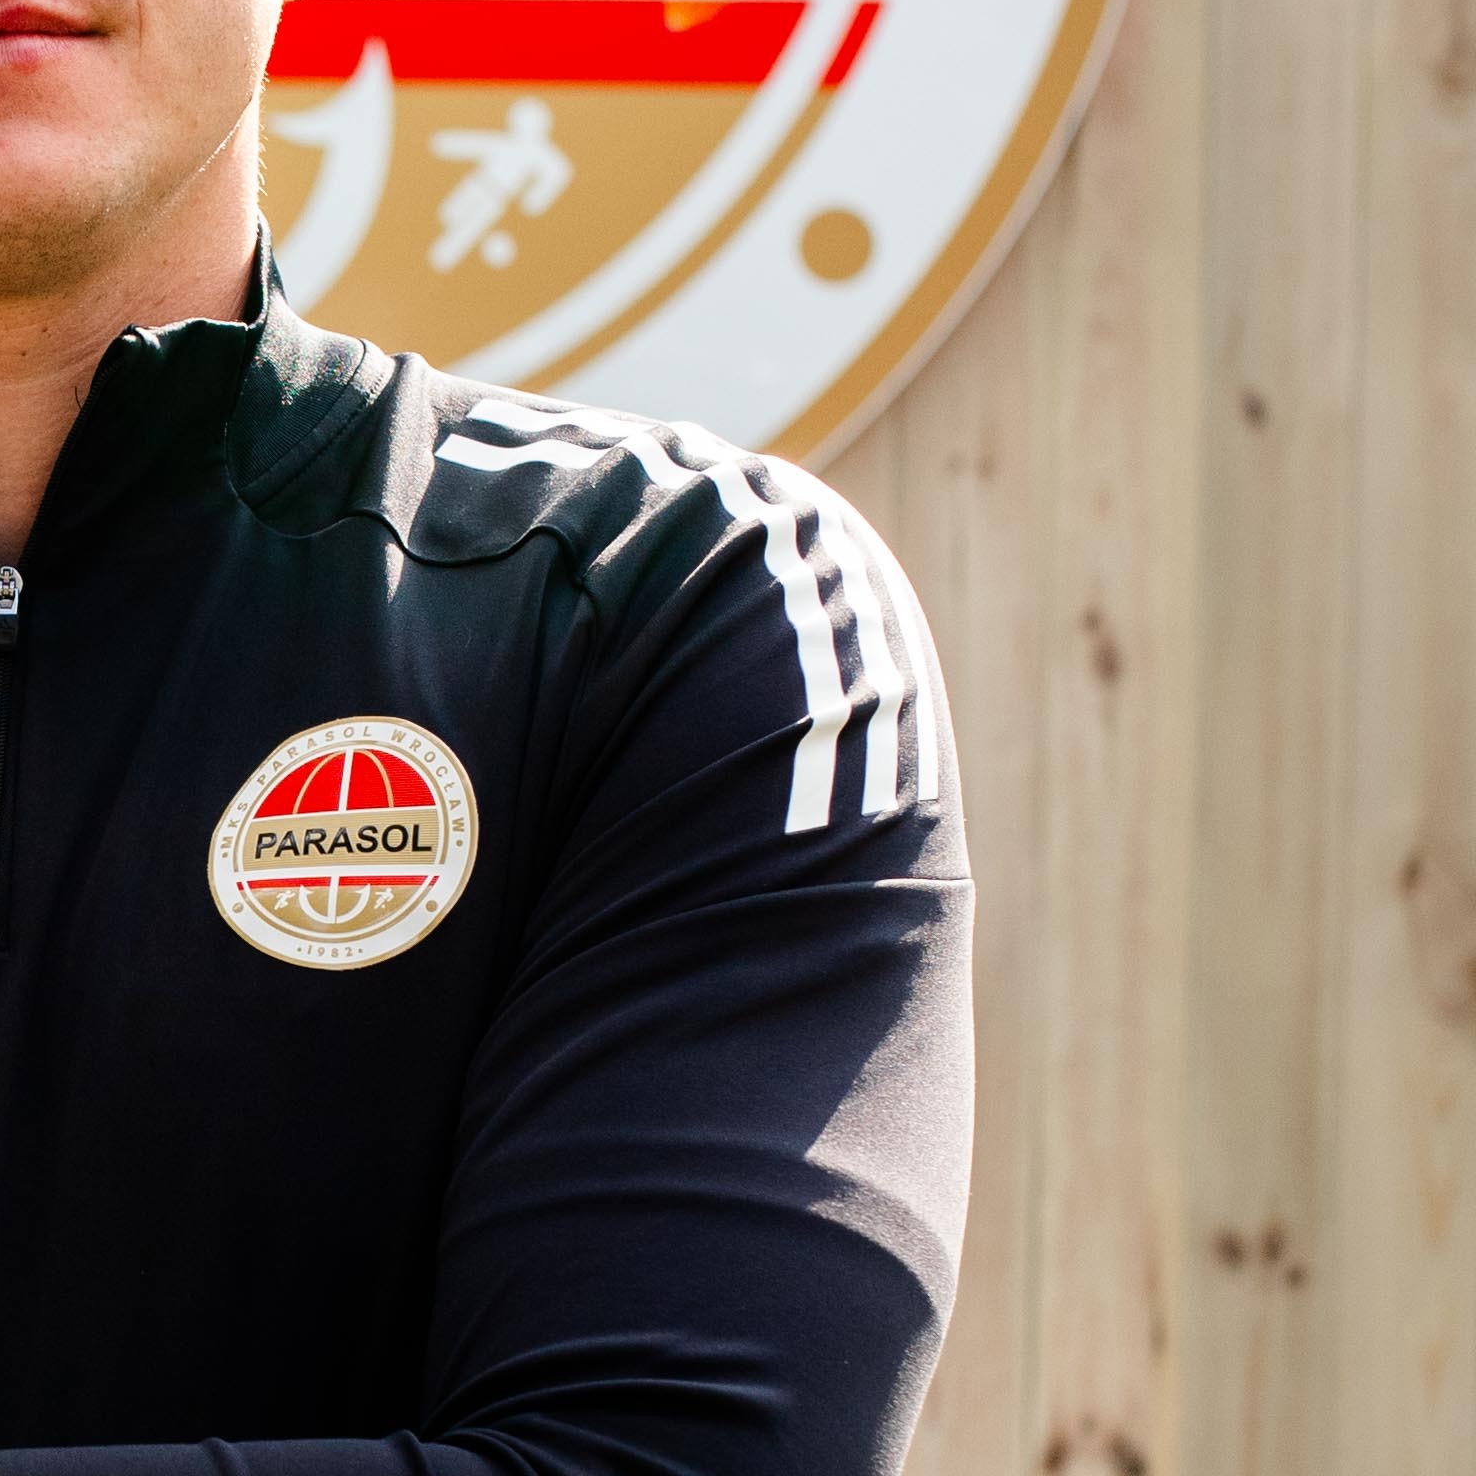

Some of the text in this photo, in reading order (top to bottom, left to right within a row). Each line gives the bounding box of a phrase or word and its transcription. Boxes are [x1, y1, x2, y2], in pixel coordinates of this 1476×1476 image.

[221, 726, 465, 849] MKS PARASOL WROCŁAW
[255, 824, 432, 860] PARASOL
[307, 944, 354, 958] 1982
